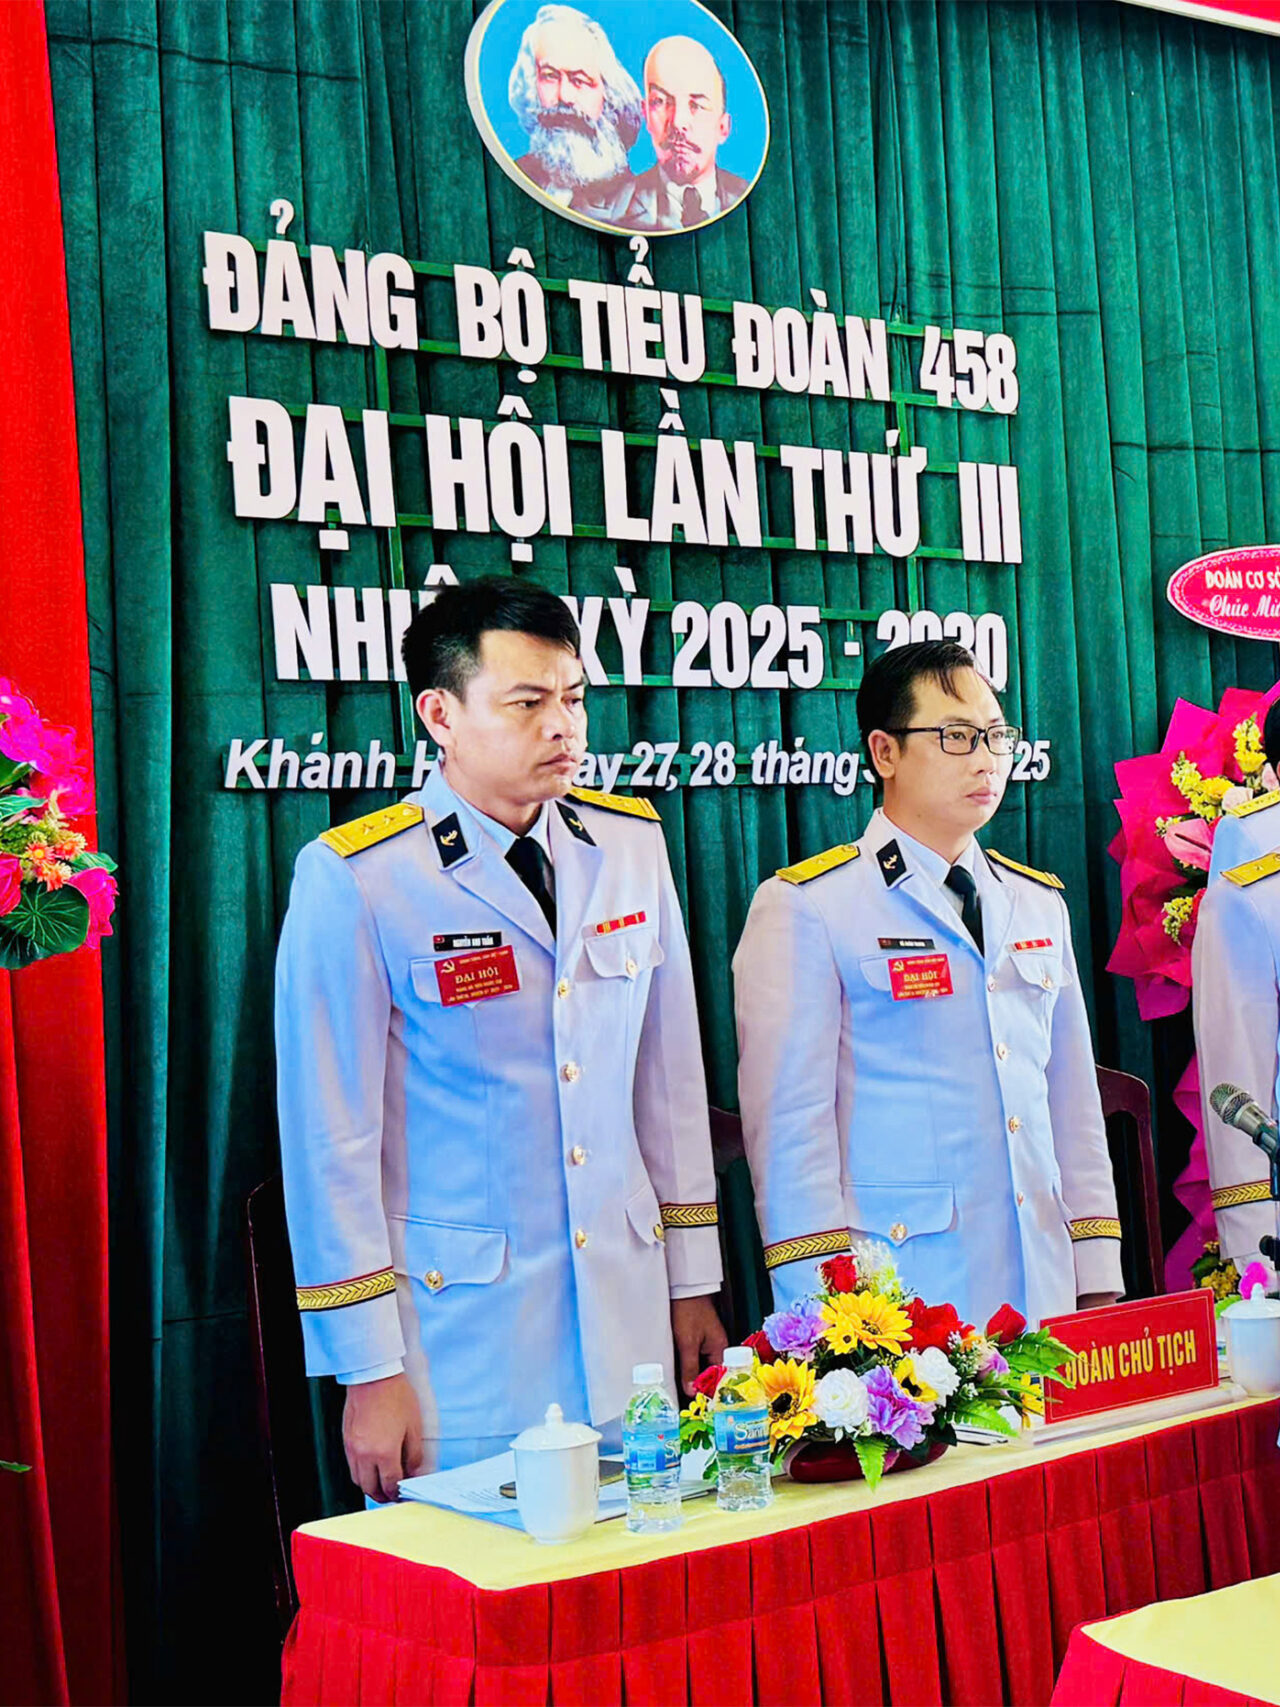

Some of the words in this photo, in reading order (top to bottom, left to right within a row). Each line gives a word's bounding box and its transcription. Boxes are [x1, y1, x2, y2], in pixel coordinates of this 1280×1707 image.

[202, 198, 419, 350] ĐẢNG
[453, 246, 548, 384] BỘ
[568, 235, 706, 383] TIỂU
[732, 288, 891, 402] ĐOÀN
[919, 325, 1020, 415] 458
[227, 395, 397, 551] ĐẠI
[425, 394, 573, 563] HỘI
[601, 388, 762, 548] LẦN
[780, 429, 927, 558] THỨ
[958, 461, 1023, 564] III
[270, 564, 460, 682] NHI
[671, 601, 824, 689] 2025
[224, 732, 396, 790] Khánh
[630, 741, 679, 792] 27,
[689, 741, 736, 786] 28
[750, 737, 859, 796] tháng
[1118, 1326, 1154, 1378] CHỦ
[1156, 1329, 1197, 1376] TỊCH
